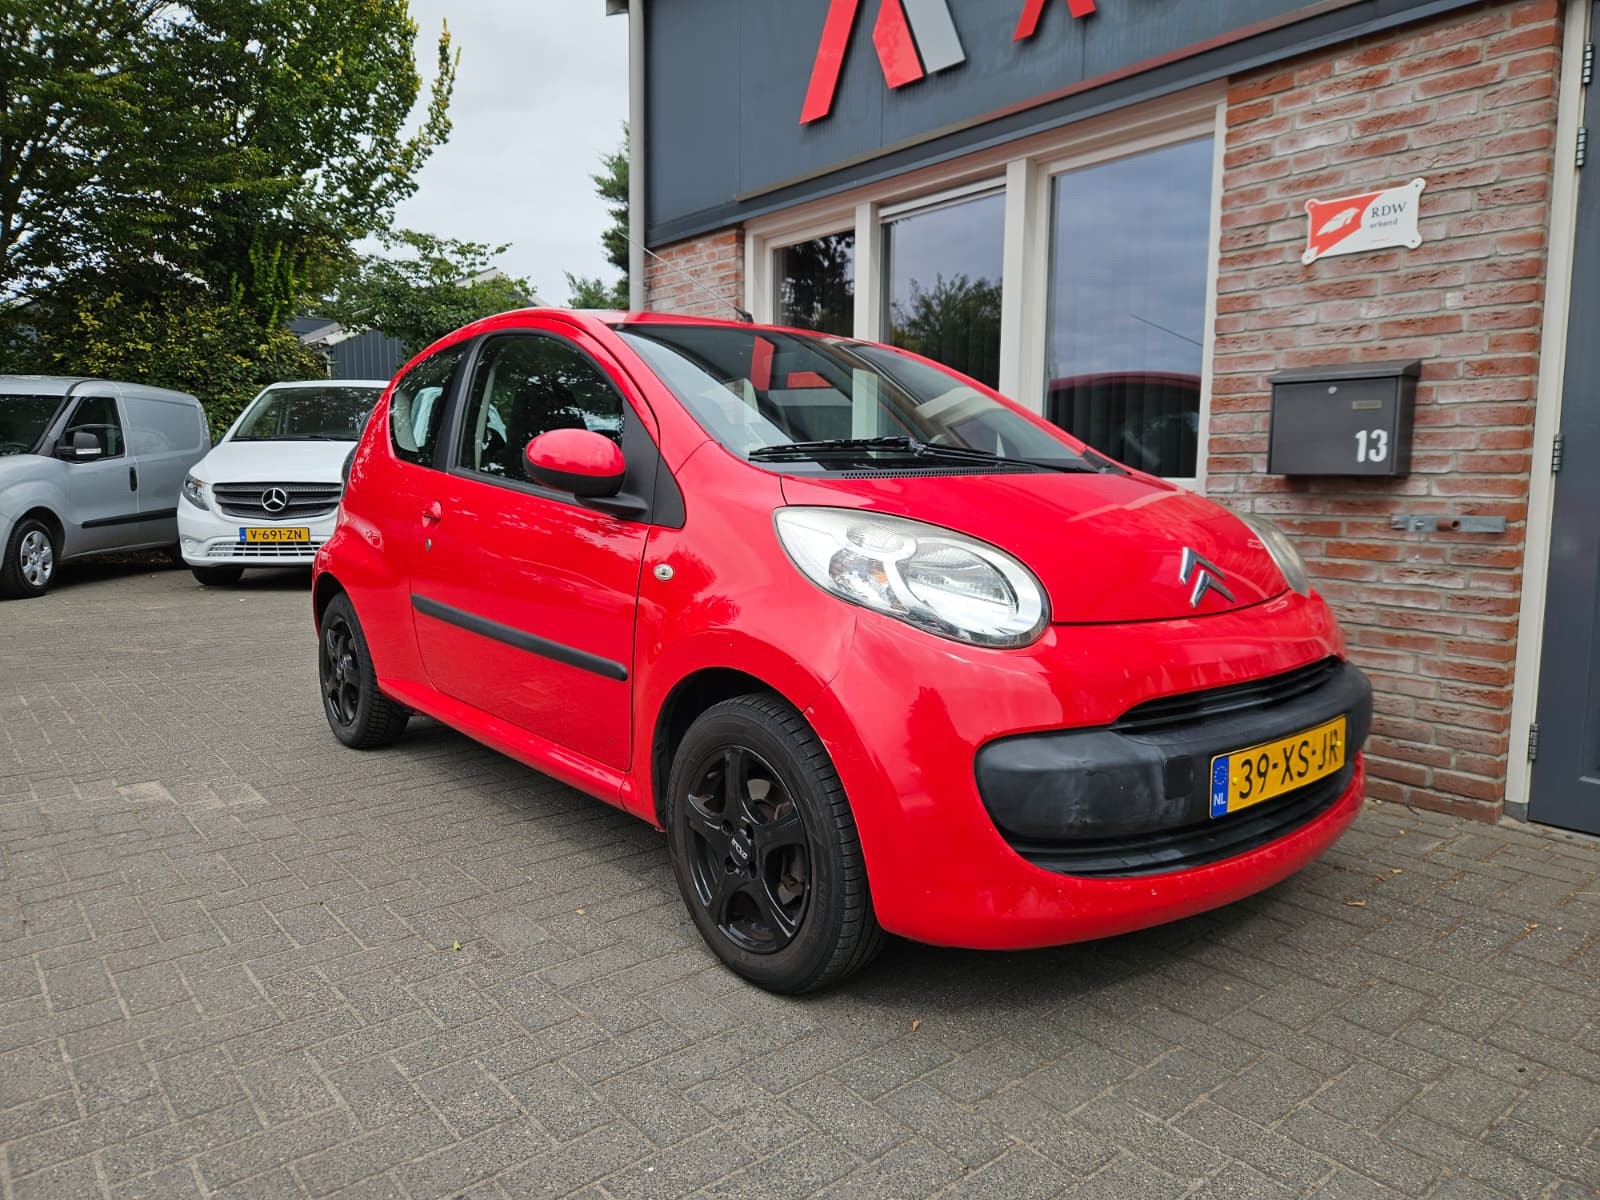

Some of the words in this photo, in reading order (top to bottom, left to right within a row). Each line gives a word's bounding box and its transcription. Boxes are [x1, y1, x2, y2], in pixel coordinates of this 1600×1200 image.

[1371, 201, 1407, 218] RDW
[1355, 428, 1388, 463] 13
[250, 529, 302, 540] V-691-ZN
[1239, 728, 1339, 800] 39-XS-JR
[1213, 792, 1227, 807] NL
